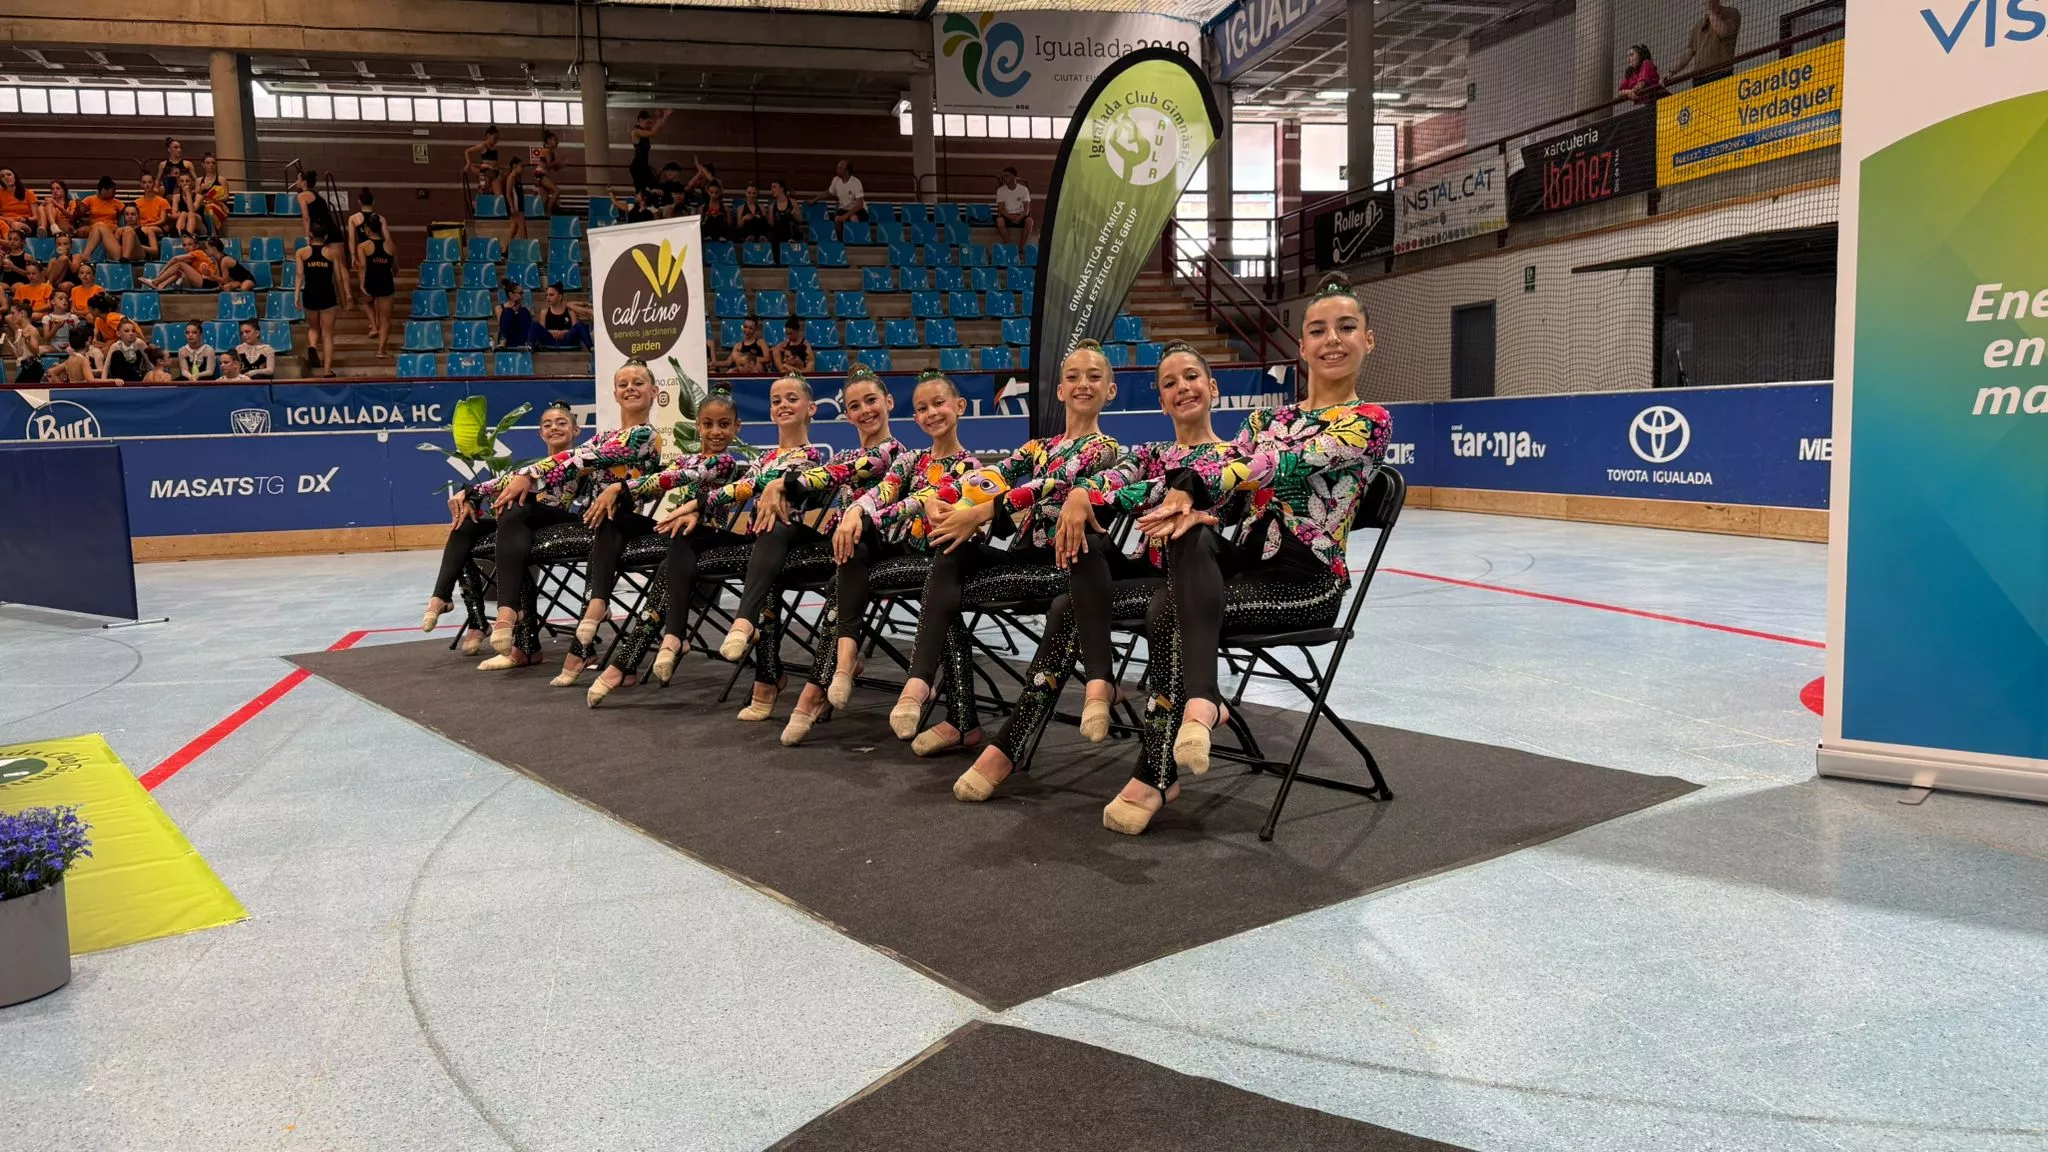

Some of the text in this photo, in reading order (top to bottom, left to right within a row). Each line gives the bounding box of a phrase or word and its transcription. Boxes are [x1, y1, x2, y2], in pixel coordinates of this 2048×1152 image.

[1054, 73, 1083, 82] CIUTAT
[1737, 63, 1813, 101] Garatge
[1738, 84, 1836, 126] Verdaguer
[1089, 100, 1122, 159] Igualada
[1125, 90, 1158, 106] Club
[1544, 128, 1599, 158] xarcuteria
[1069, 200, 1126, 312] GIMNÀSTICA RÍTMICA
[1089, 254, 1116, 303] ESTÈTICA
[1112, 236, 1124, 255] DE
[1119, 207, 1138, 238] GRUP
[612, 290, 681, 326] cal tino
[631, 340, 661, 354] garden
[1983, 337, 2046, 368] en
[286, 404, 442, 425] IGUALADA HC
[297, 466, 340, 493] DX
[1607, 468, 1713, 485] TOYOTA IGUALADA
